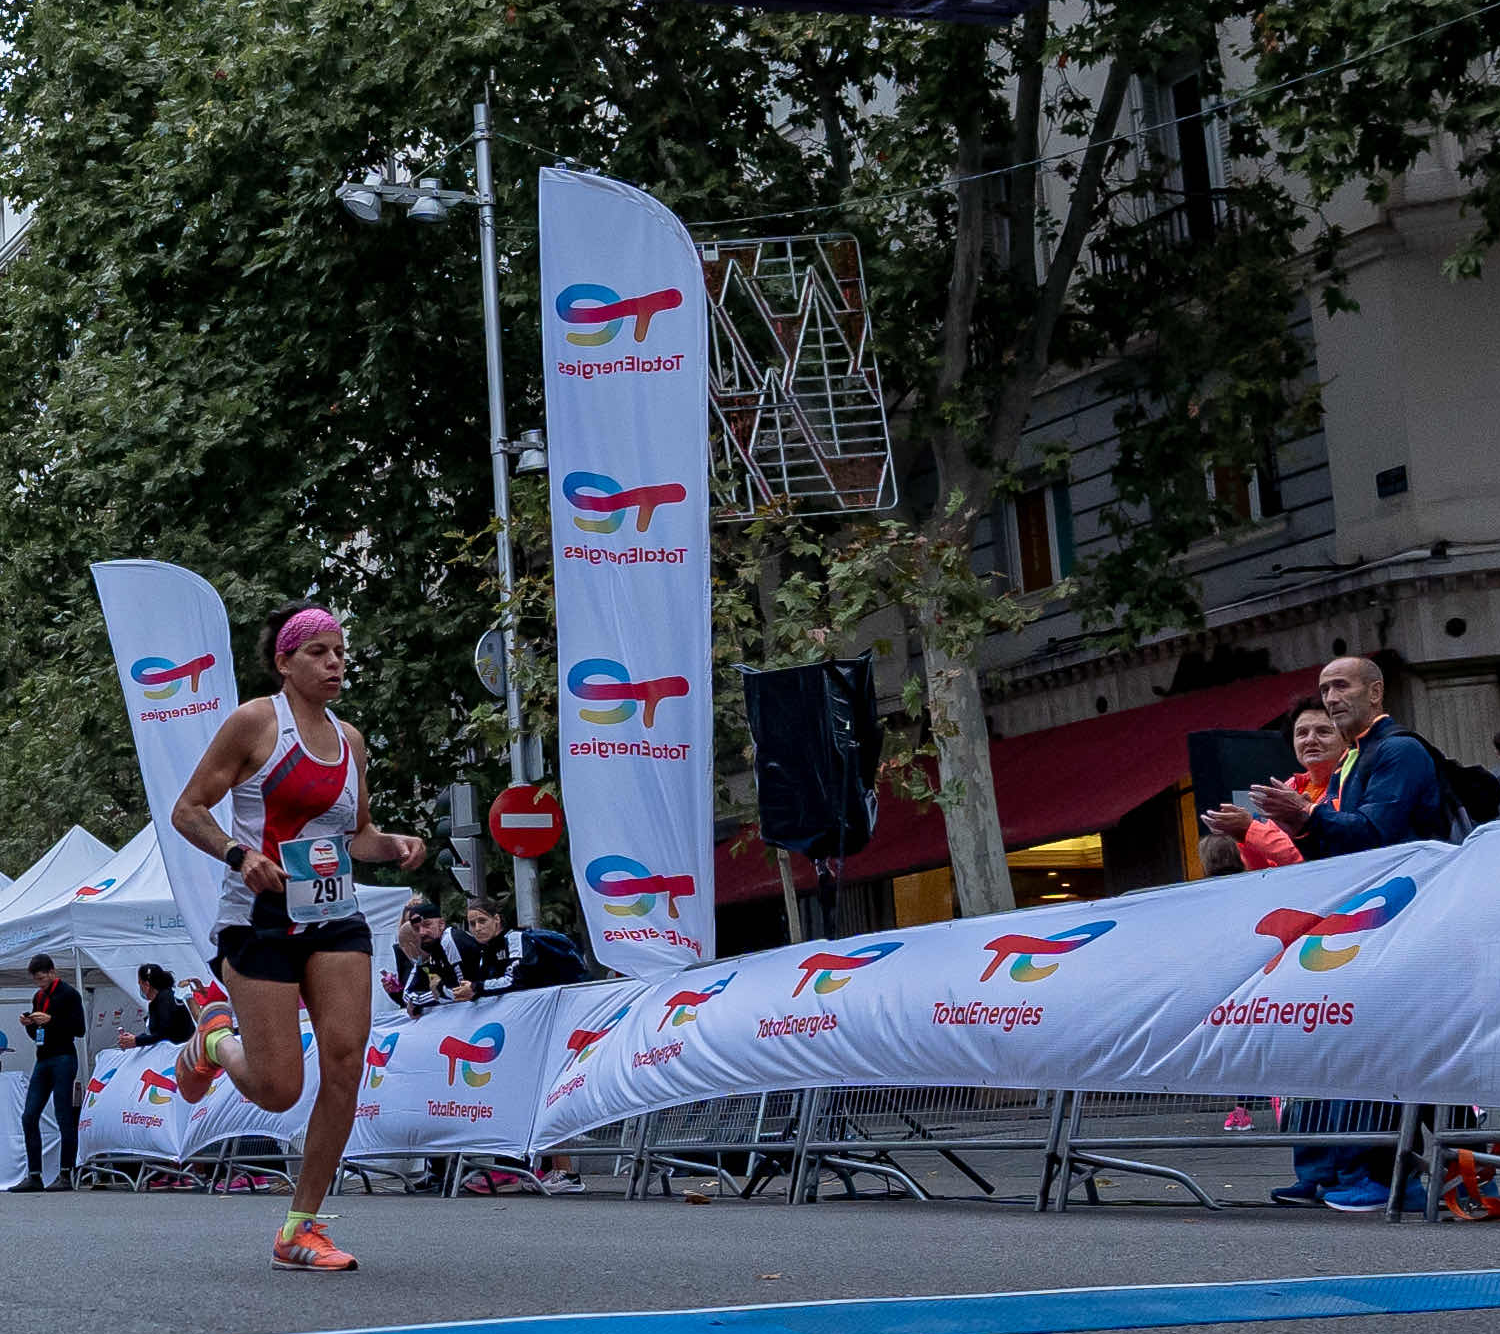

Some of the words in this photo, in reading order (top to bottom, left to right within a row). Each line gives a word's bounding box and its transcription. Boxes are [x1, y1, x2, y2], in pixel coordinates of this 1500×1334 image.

[931, 1000, 1044, 1033] TotalEnergies
[1202, 995, 1355, 1034] otalEnergies
[427, 1100, 494, 1123] TotalEnergies
